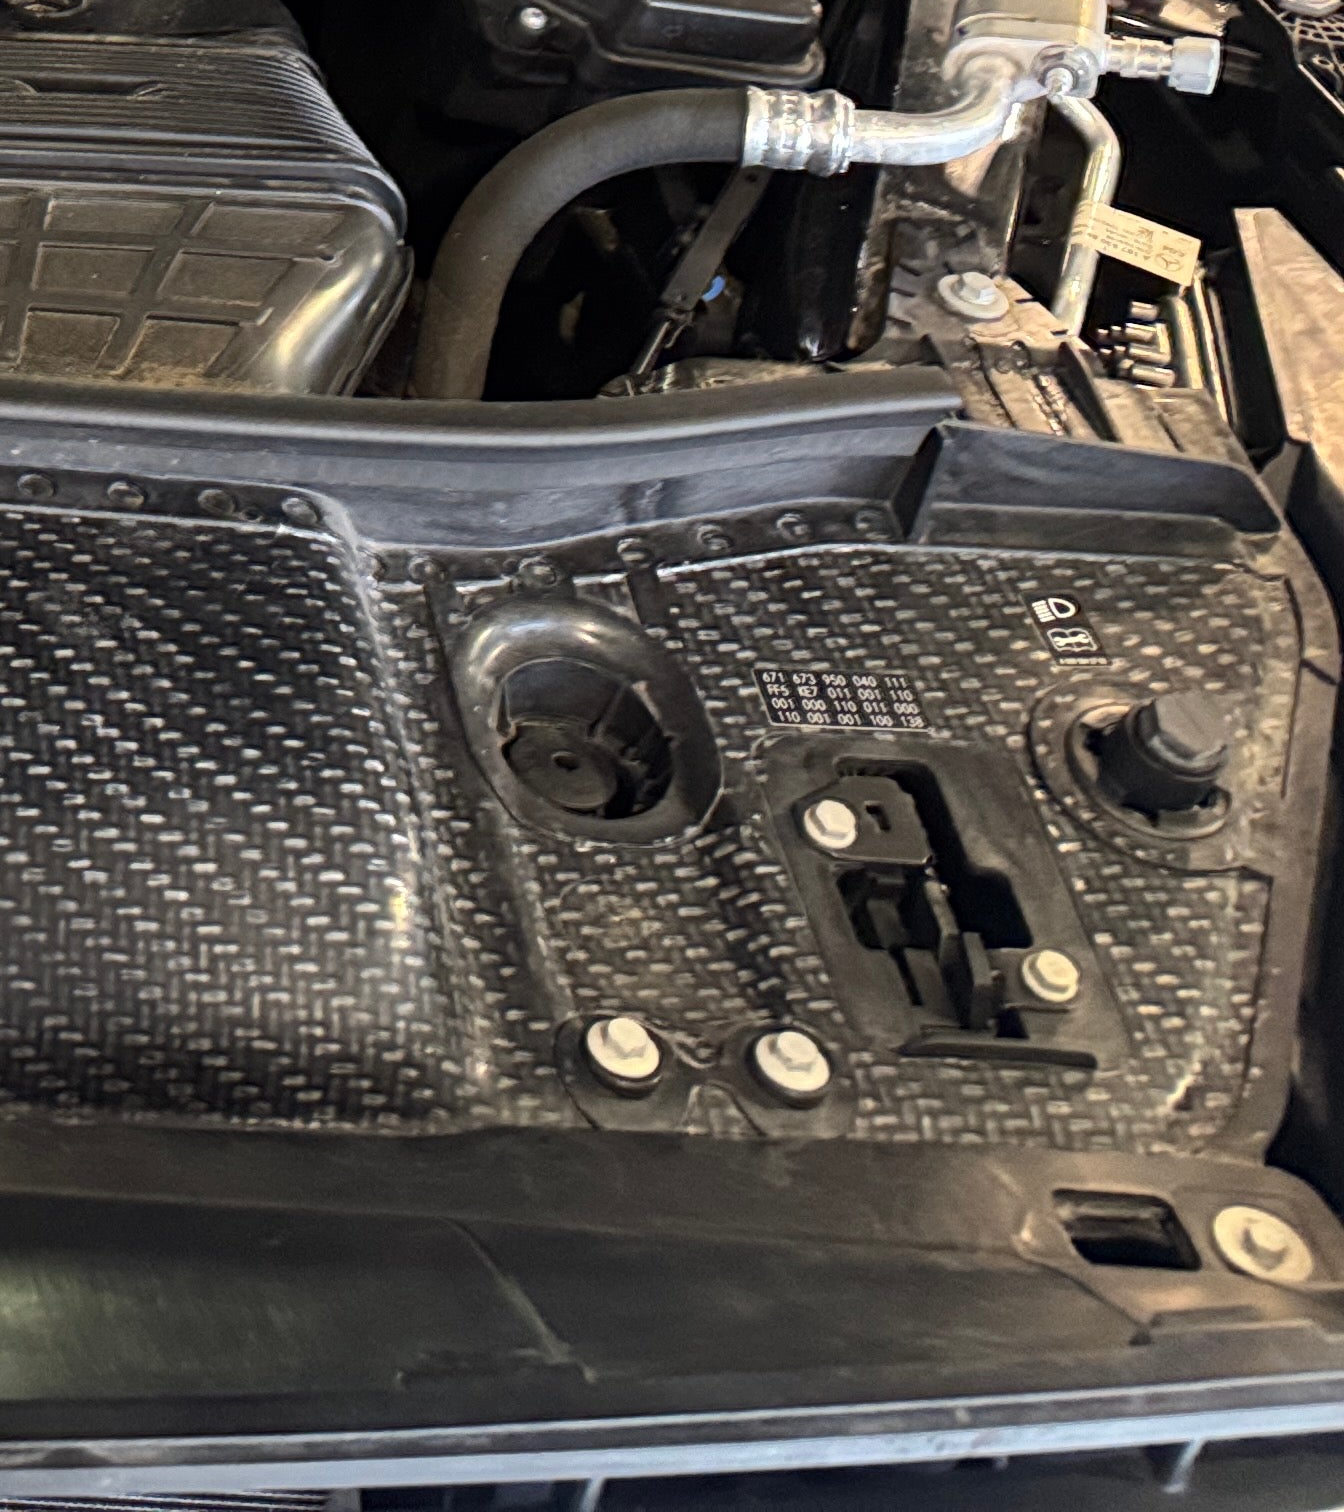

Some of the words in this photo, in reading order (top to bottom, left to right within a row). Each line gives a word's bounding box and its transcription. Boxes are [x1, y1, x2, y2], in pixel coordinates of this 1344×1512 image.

[762, 671, 785, 683] 671
[792, 673, 816, 685] 673
[822, 674, 847, 686] 950
[852, 675, 877, 687] 040
[884, 677, 908, 688] 111
[827, 686, 852, 699] 011
[857, 688, 882, 700] 001
[889, 689, 913, 701] 110
[771, 697, 796, 709] 001
[801, 698, 827, 711] 000
[833, 700, 858, 712] 110
[862, 701, 888, 713] 011
[893, 702, 919, 714] 000
[777, 710, 801, 723] 110
[806, 711, 832, 724] 001
[837, 713, 862, 725] 001
[869, 714, 894, 727] 100
